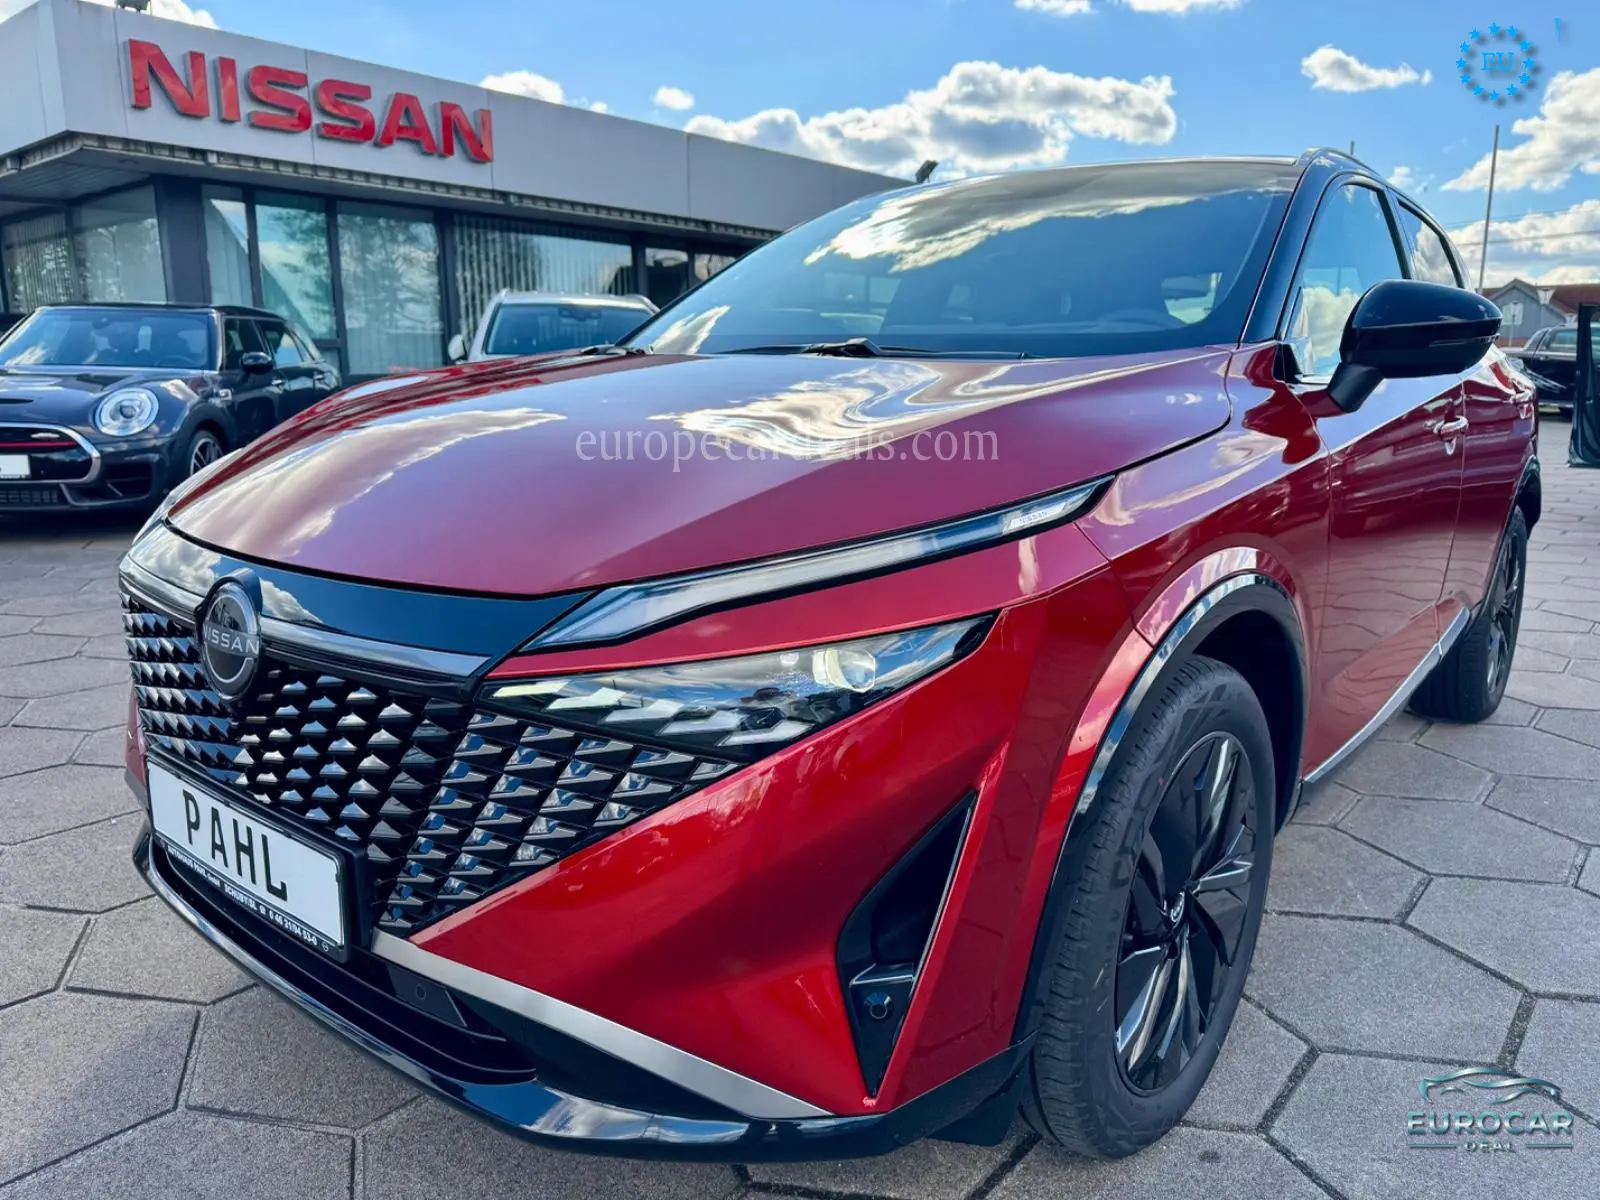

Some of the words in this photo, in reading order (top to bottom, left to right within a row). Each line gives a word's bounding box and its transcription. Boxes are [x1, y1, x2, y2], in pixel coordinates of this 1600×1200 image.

[127, 38, 493, 163] NISSAN
[203, 623, 260, 655] NISSAN
[182, 789, 288, 902] PAHL
